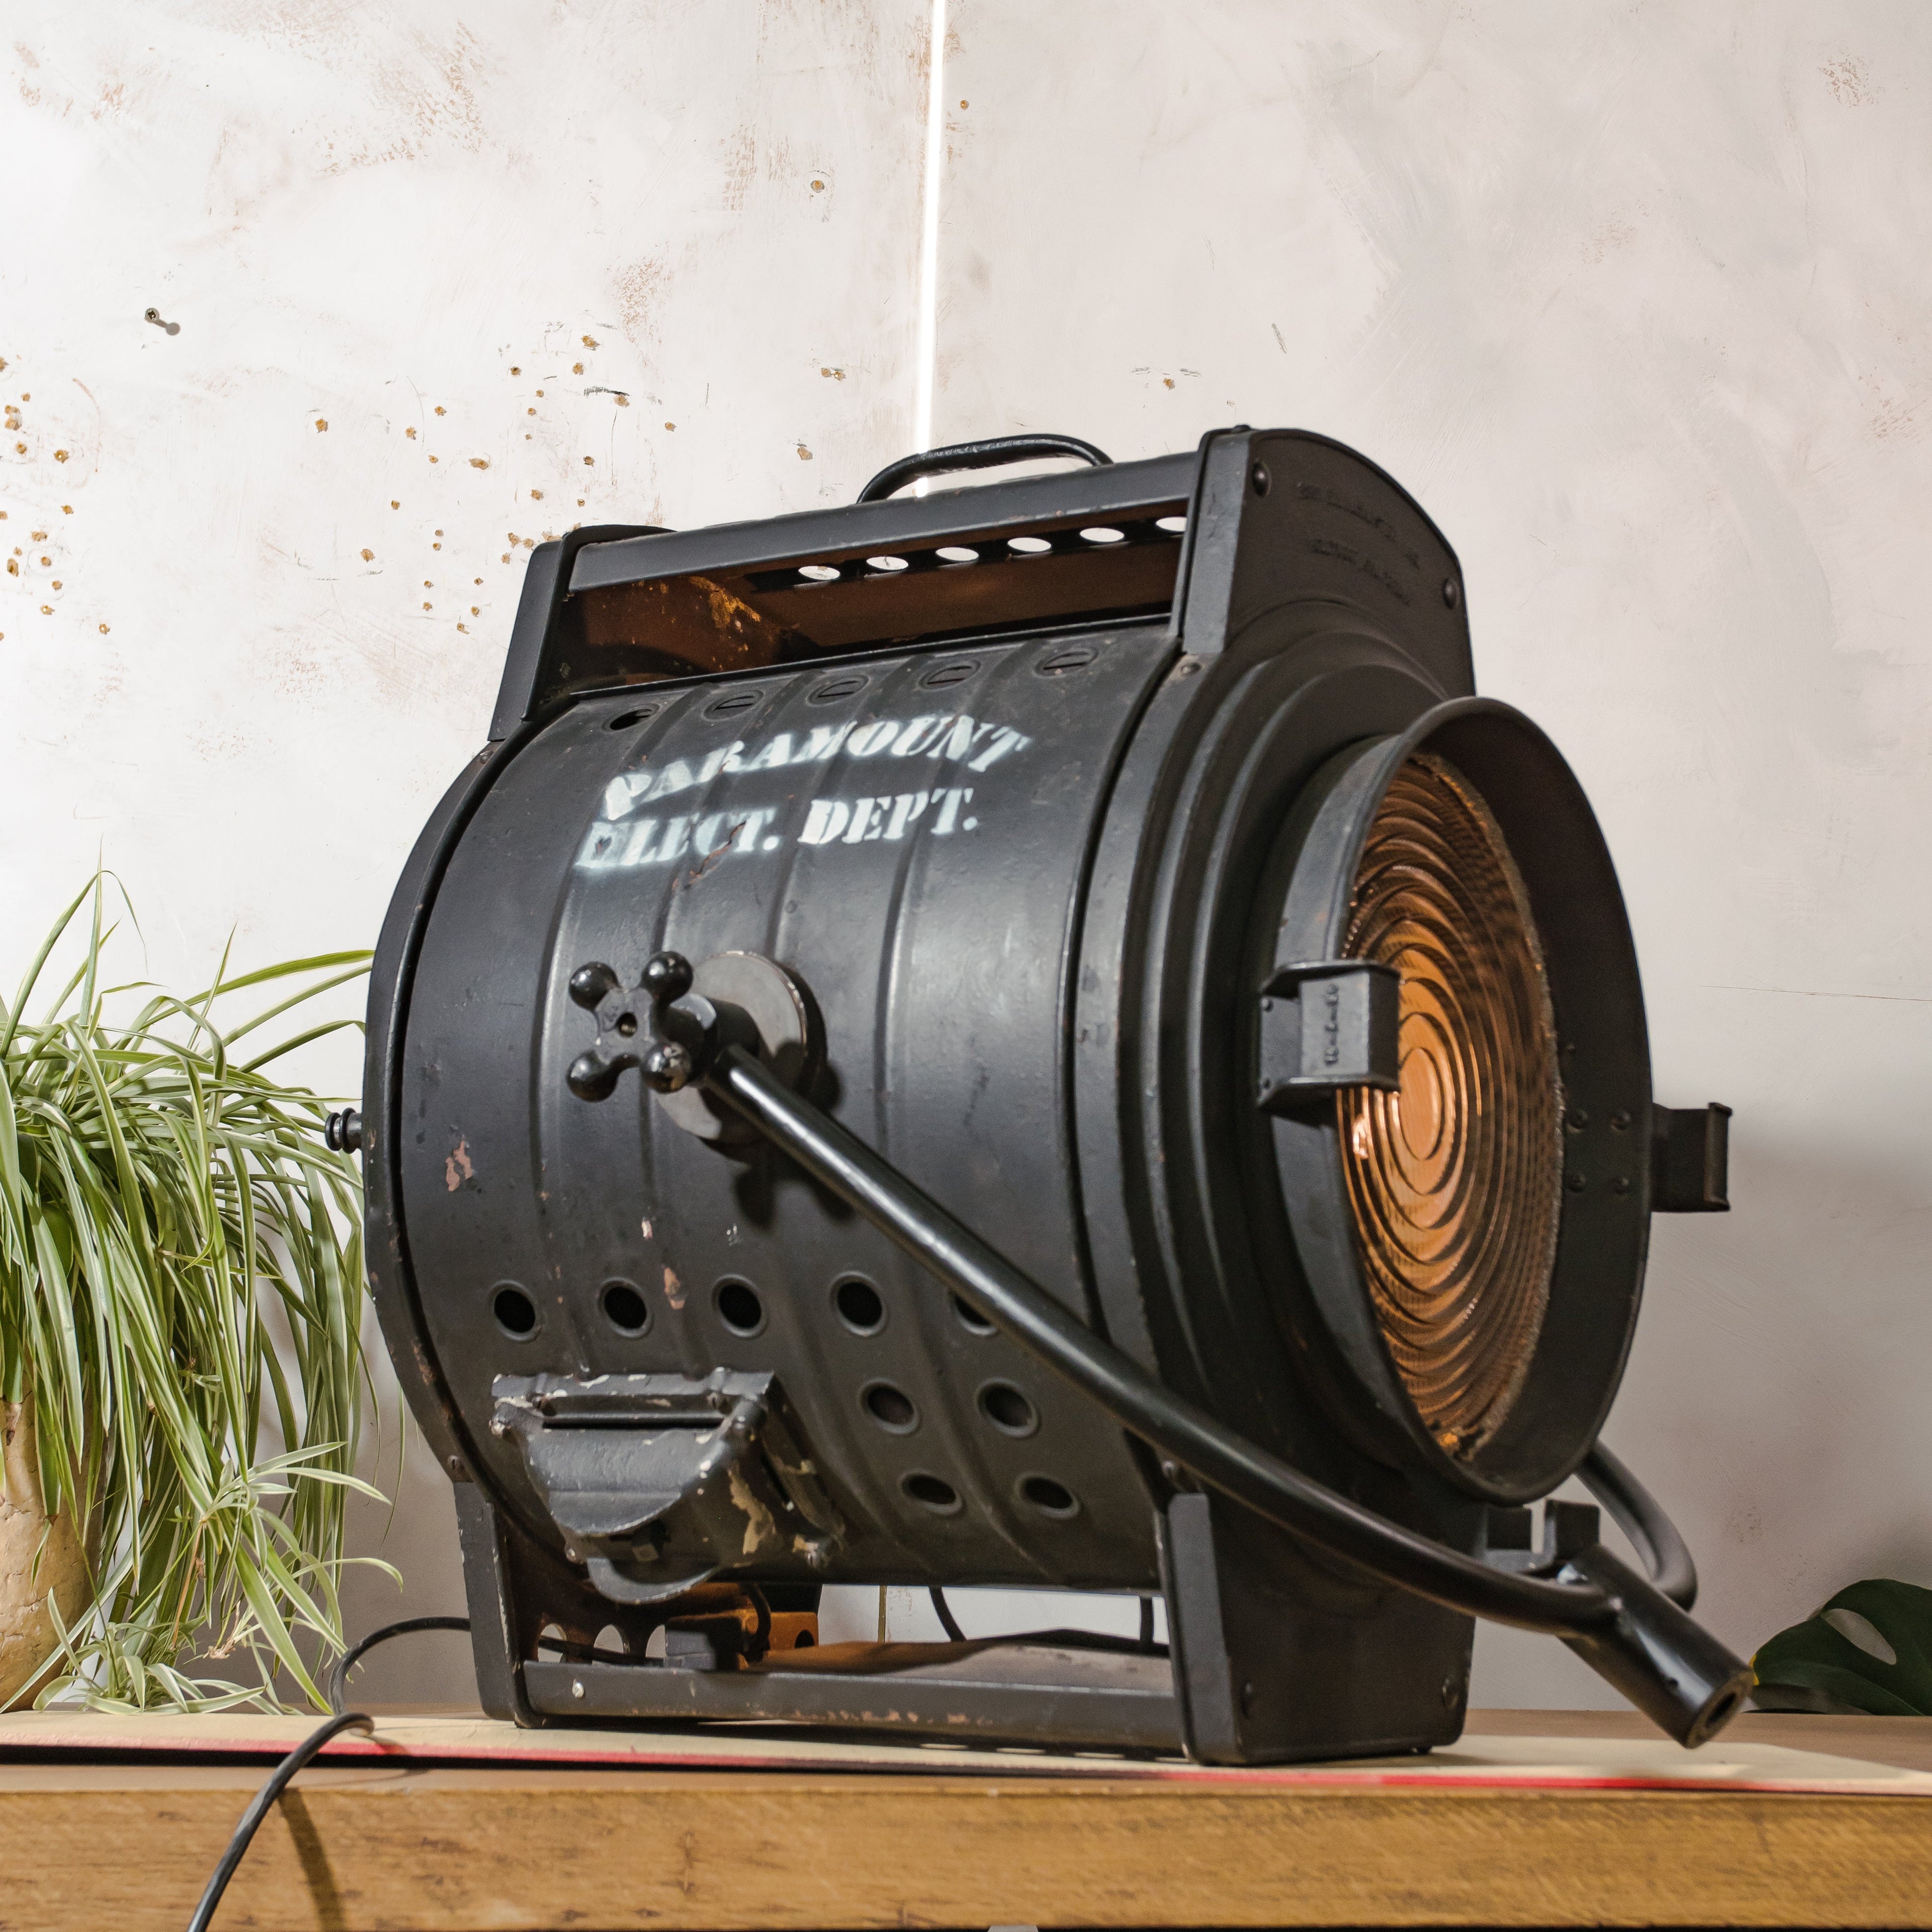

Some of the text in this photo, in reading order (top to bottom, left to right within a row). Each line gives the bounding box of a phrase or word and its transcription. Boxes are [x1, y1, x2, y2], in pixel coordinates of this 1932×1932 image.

[605, 714, 1032, 821] PARAMOUNT
[575, 787, 979, 868] ELECT. DEPT.
